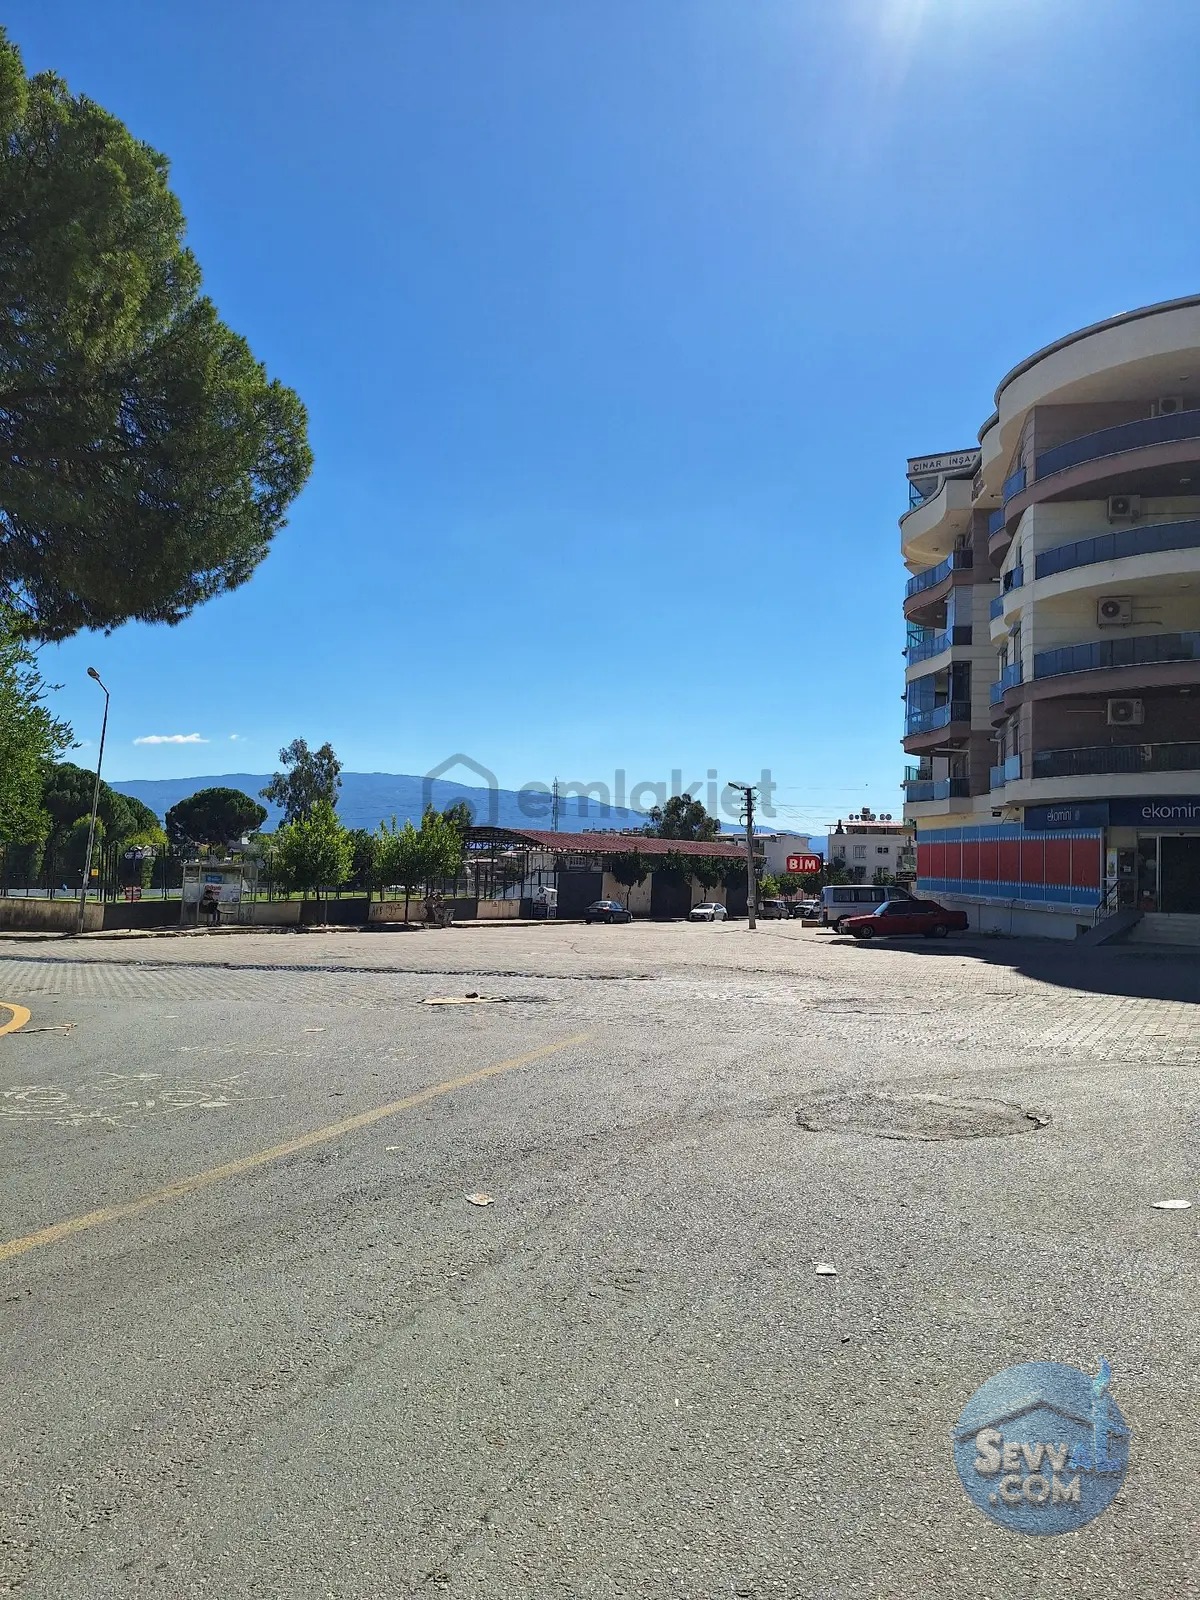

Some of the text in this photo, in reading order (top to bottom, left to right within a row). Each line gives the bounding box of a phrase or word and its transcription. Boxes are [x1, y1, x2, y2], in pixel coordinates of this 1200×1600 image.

[913, 460, 942, 472] ÇINAR
[1047, 808, 1072, 822] ekomini
[789, 857, 816, 870] BİM
